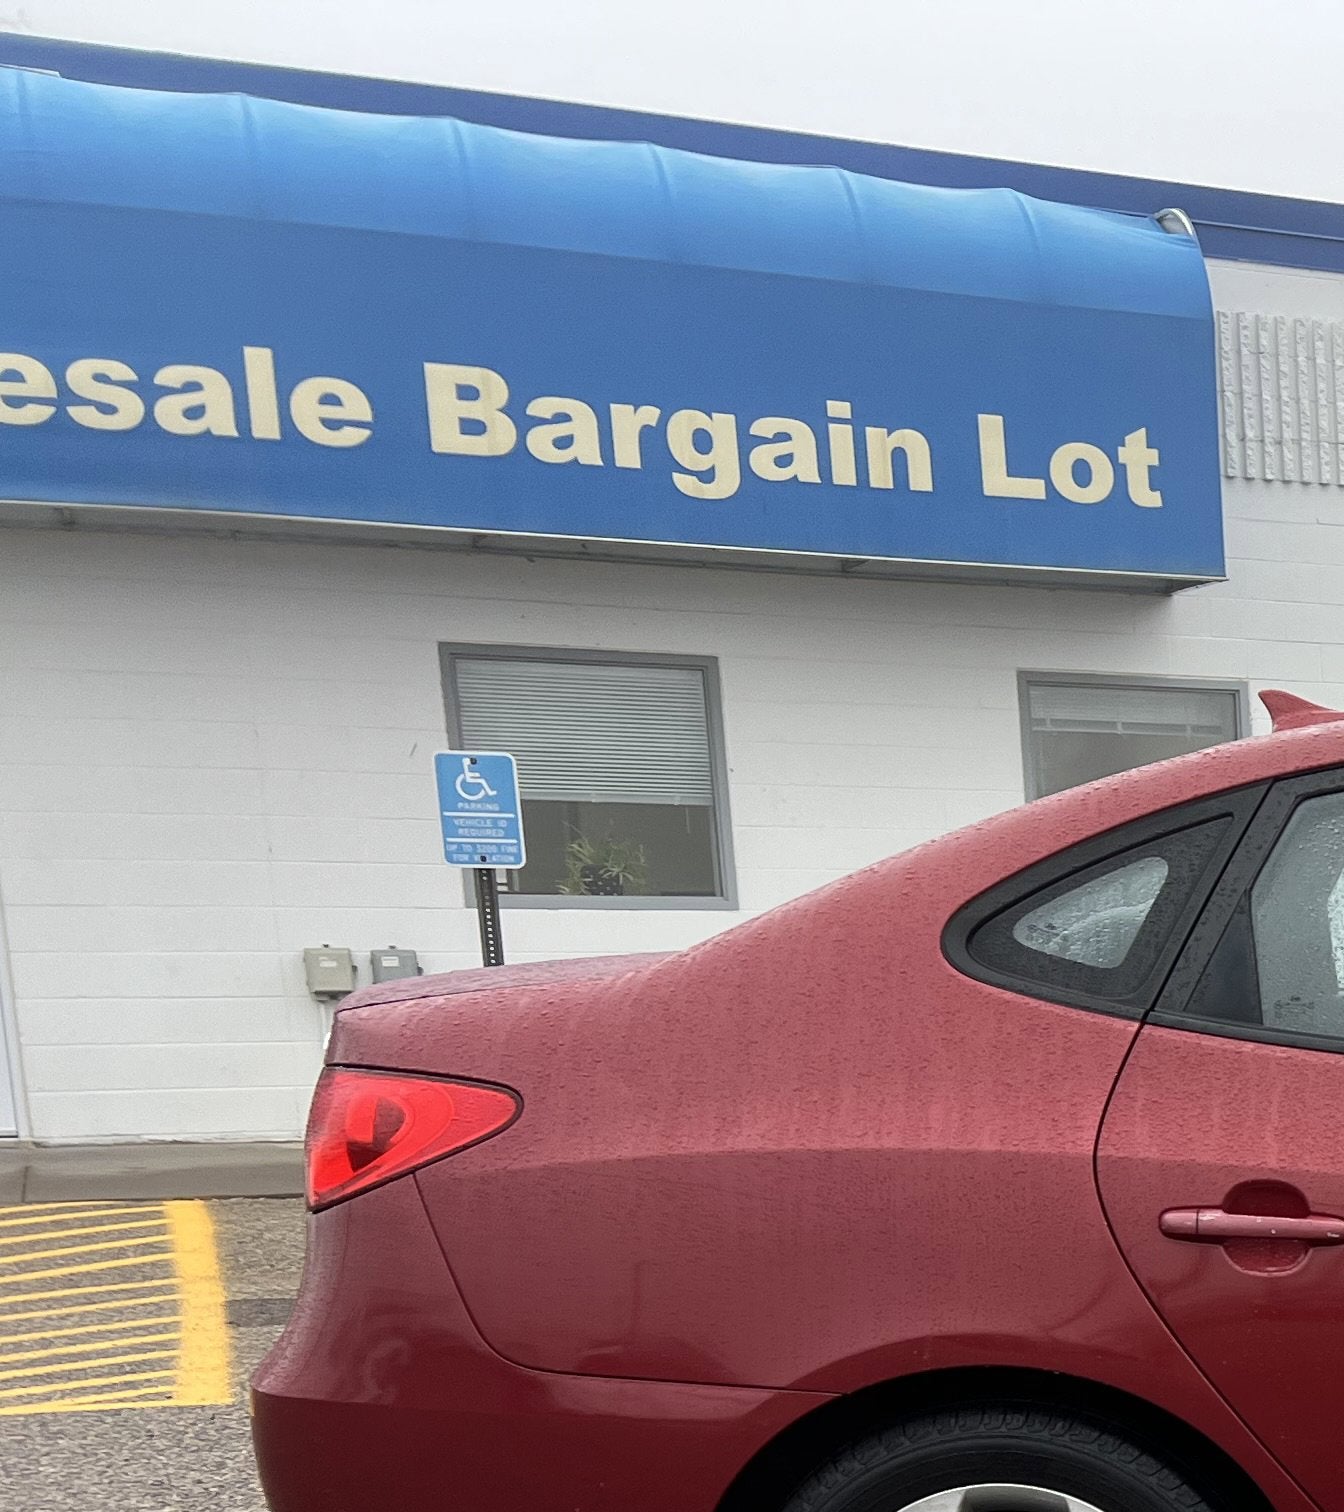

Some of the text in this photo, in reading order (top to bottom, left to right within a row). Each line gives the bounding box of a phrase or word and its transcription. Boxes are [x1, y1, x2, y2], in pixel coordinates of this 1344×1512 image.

[0, 346, 1163, 508] esale Bargain Lot
[457, 802, 500, 811] PARKING
[453, 818, 494, 827] VEHICLE
[457, 828, 505, 838] REQUIRED
